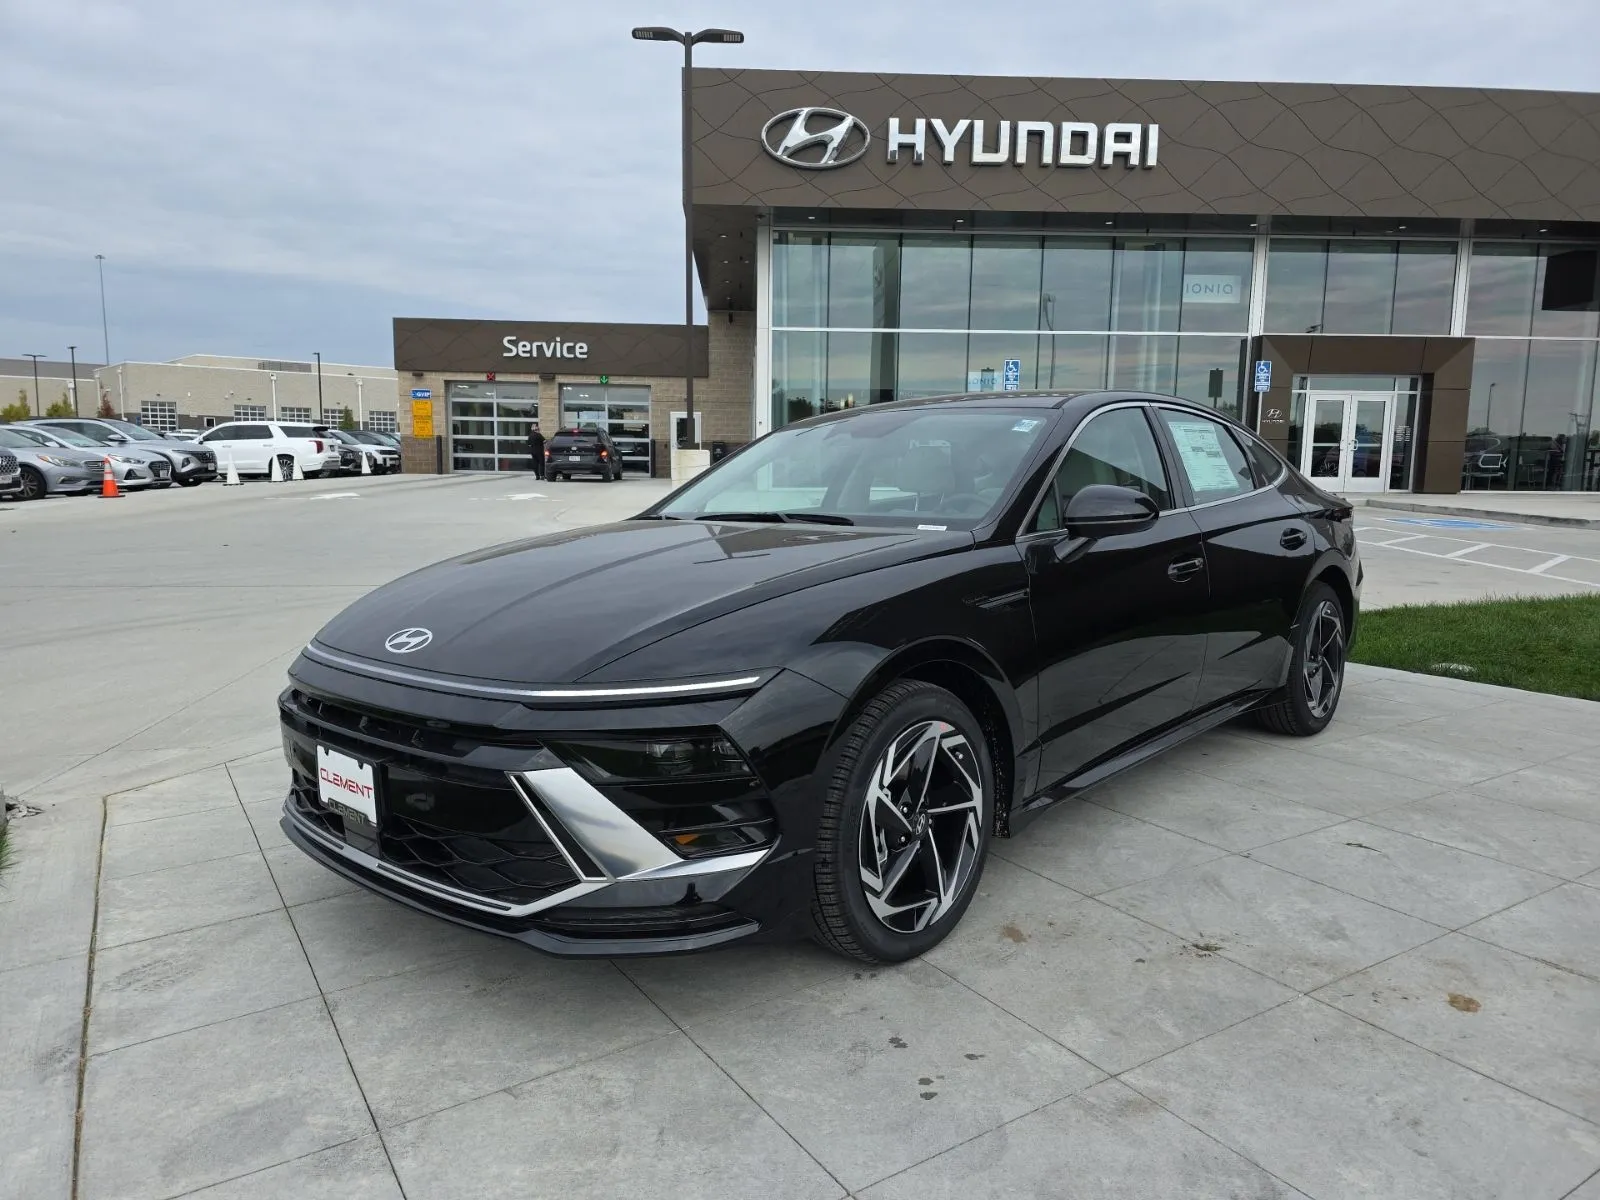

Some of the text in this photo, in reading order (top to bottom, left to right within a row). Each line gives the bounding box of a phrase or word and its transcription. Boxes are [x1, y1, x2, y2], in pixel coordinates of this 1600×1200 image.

[886, 117, 1160, 169] HYUNDAI
[1186, 283, 1233, 294] IONIQ
[503, 335, 588, 359] Service
[320, 767, 373, 799] CLEMENT
[328, 799, 365, 825] CLEMENT
